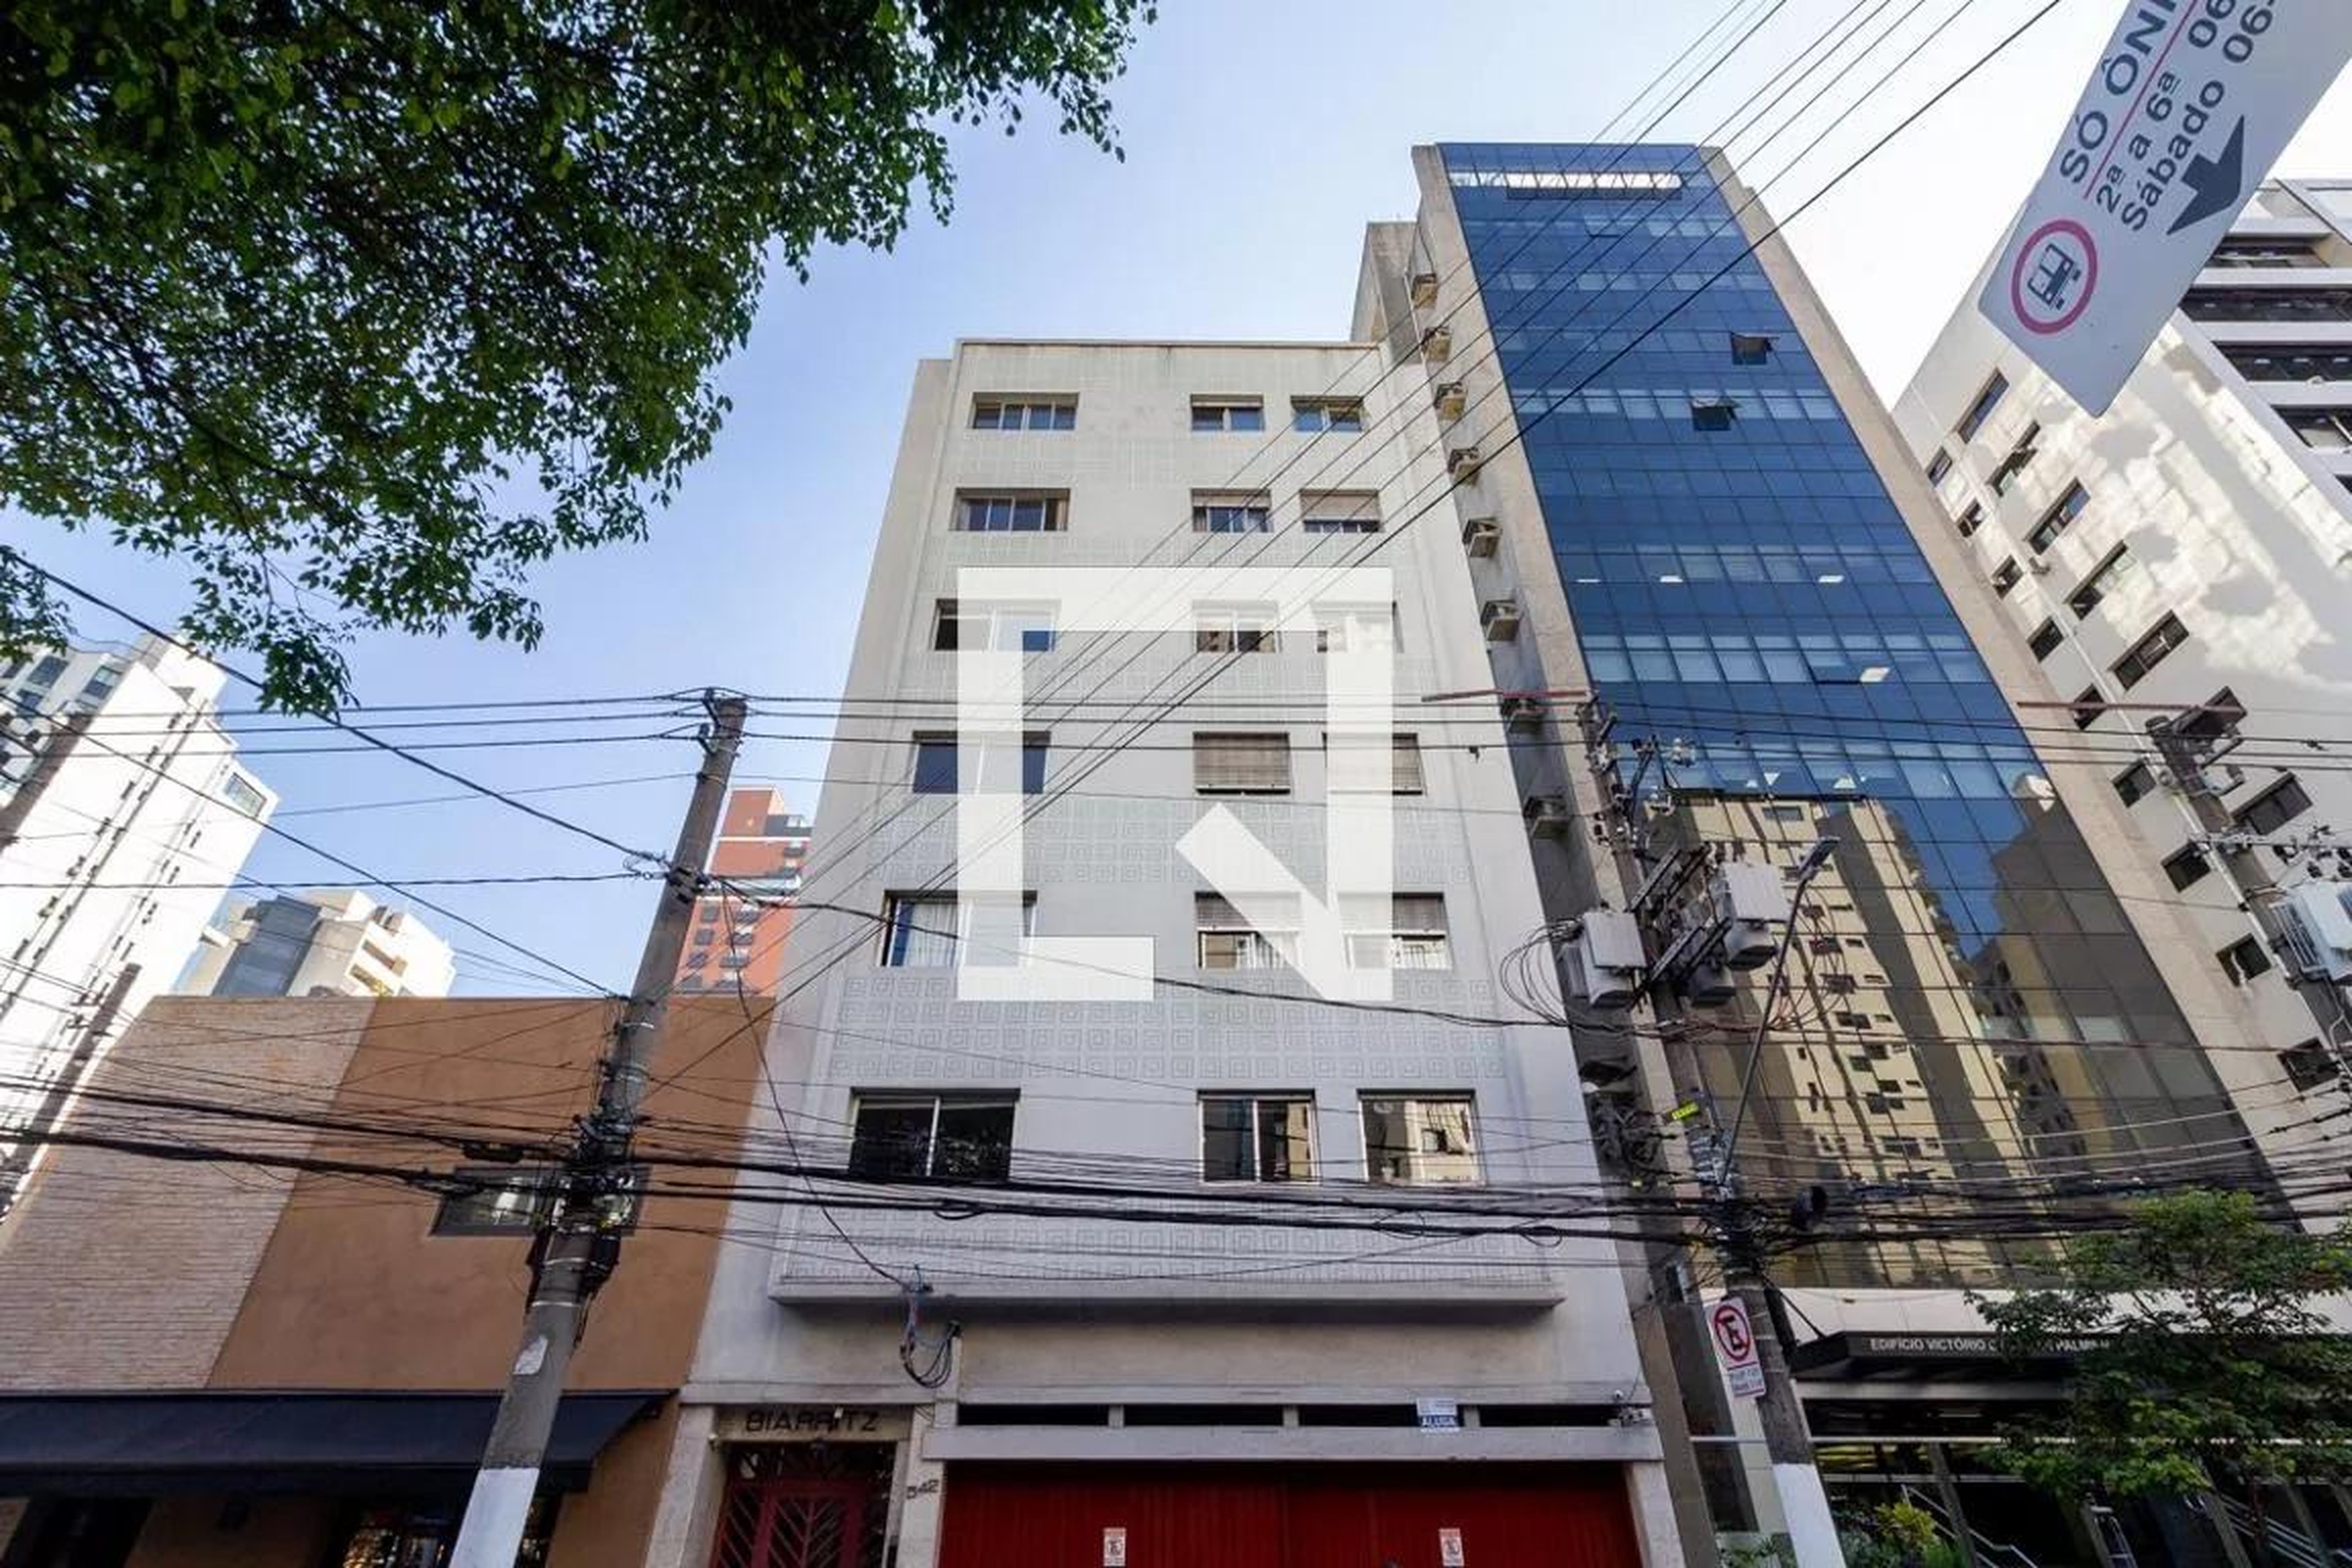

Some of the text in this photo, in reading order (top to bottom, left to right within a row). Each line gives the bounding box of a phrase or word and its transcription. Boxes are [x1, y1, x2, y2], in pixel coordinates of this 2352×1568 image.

[2059, 110, 2109, 184] SÓ
[2120, 80, 2226, 232] Sábado
[2128, 133, 2153, 160] a
